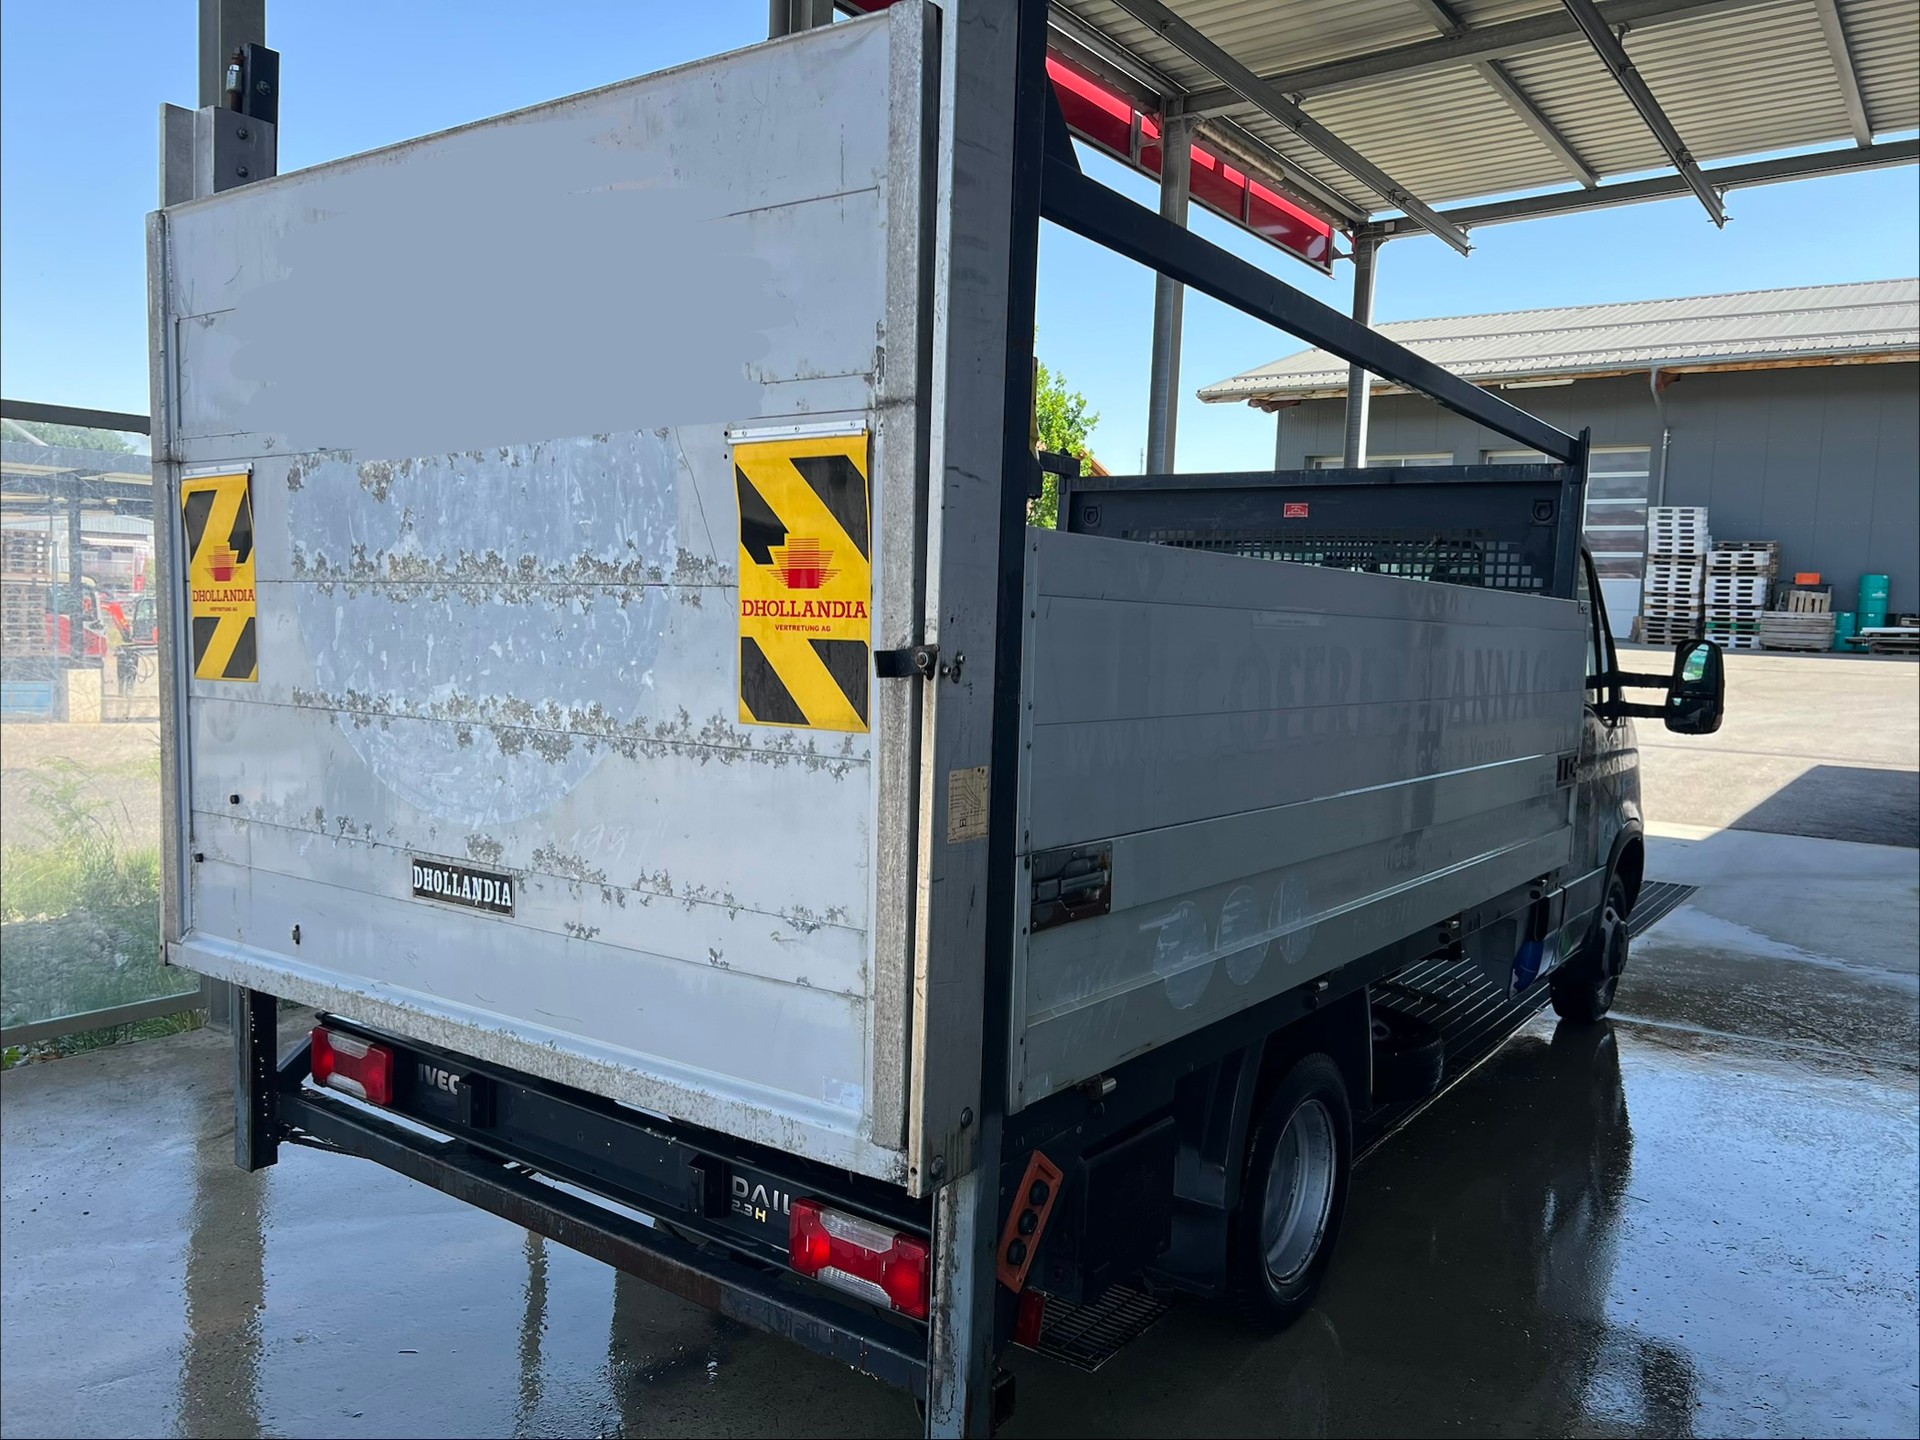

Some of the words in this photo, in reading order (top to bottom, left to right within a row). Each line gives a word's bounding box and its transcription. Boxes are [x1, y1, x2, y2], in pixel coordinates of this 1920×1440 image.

[192, 589, 255, 602] DHOLLANDIA
[741, 600, 868, 618] DHOLLANDIA
[775, 624, 820, 632] VERTRETUNG
[413, 865, 512, 907] DHOLLANDIA
[418, 1063, 460, 1096] IVEC
[732, 1175, 791, 1216] DAIL
